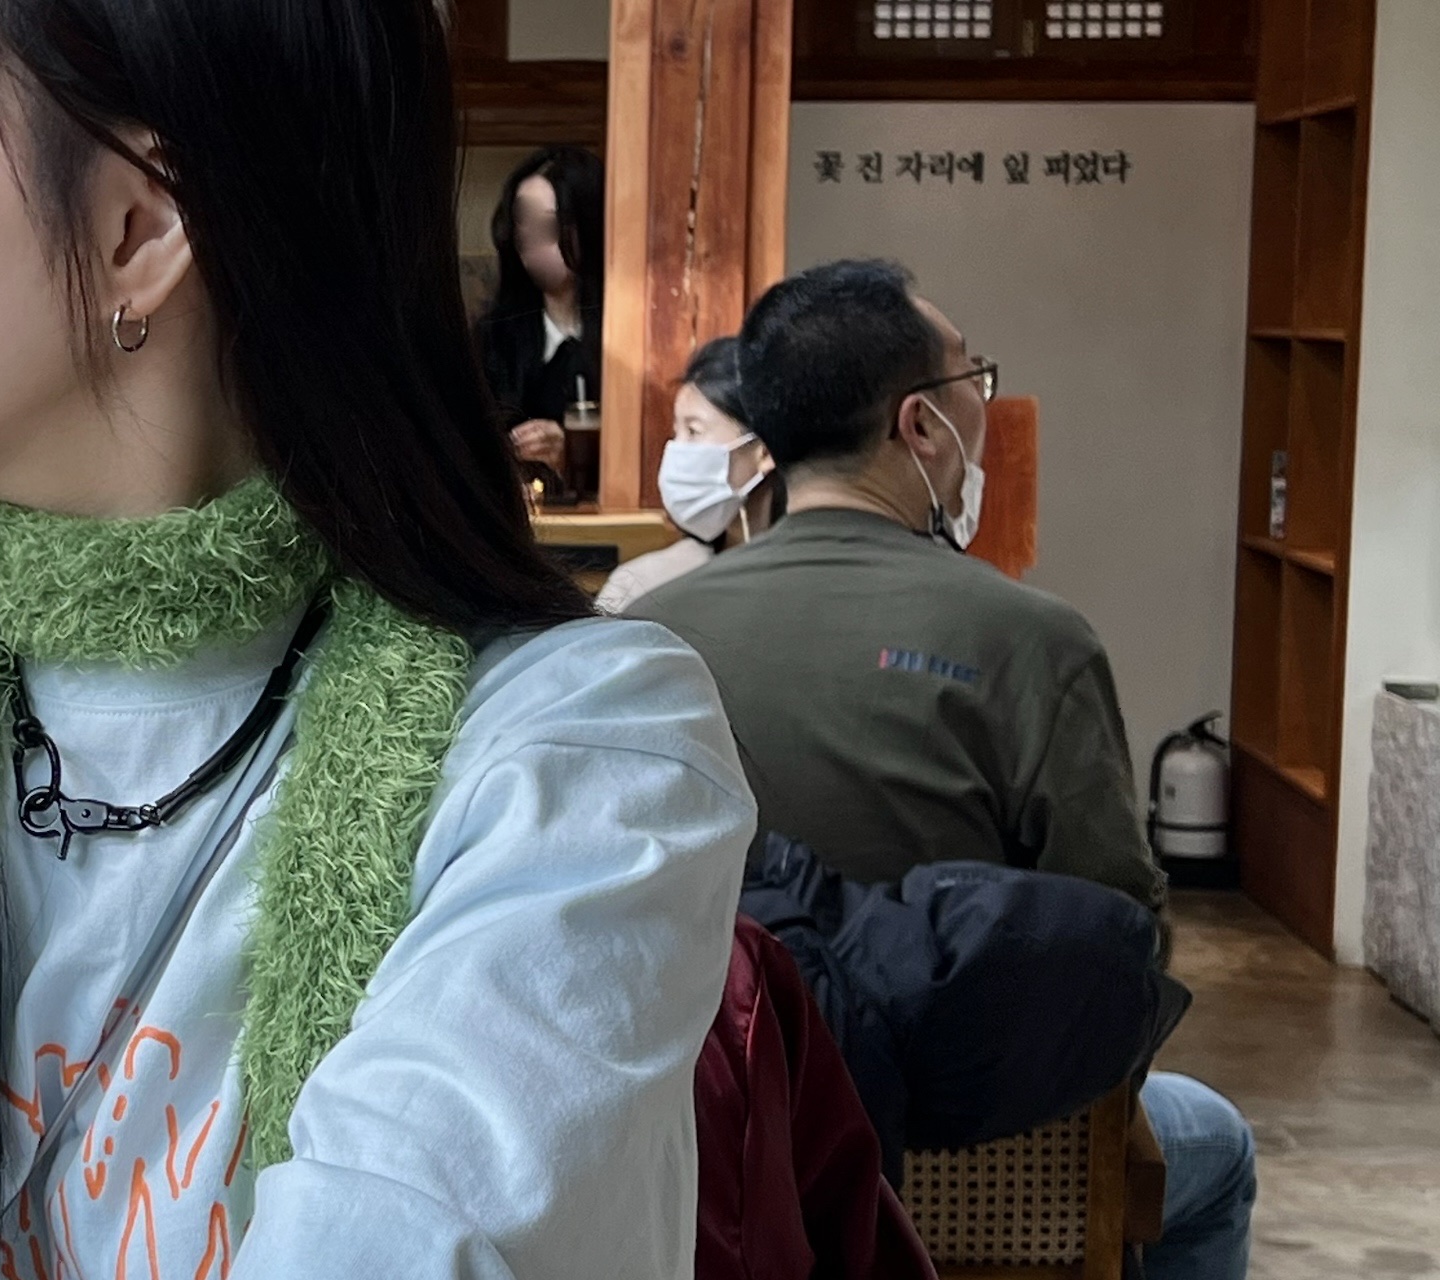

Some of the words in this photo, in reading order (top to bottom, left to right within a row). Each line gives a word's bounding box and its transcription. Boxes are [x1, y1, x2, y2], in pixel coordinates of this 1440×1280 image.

[814, 150, 845, 184] 꽃
[858, 150, 883, 184] 진
[896, 150, 985, 185] 자리에
[1003, 150, 1030, 185] 잎
[1044, 149, 1131, 185] 피었다
